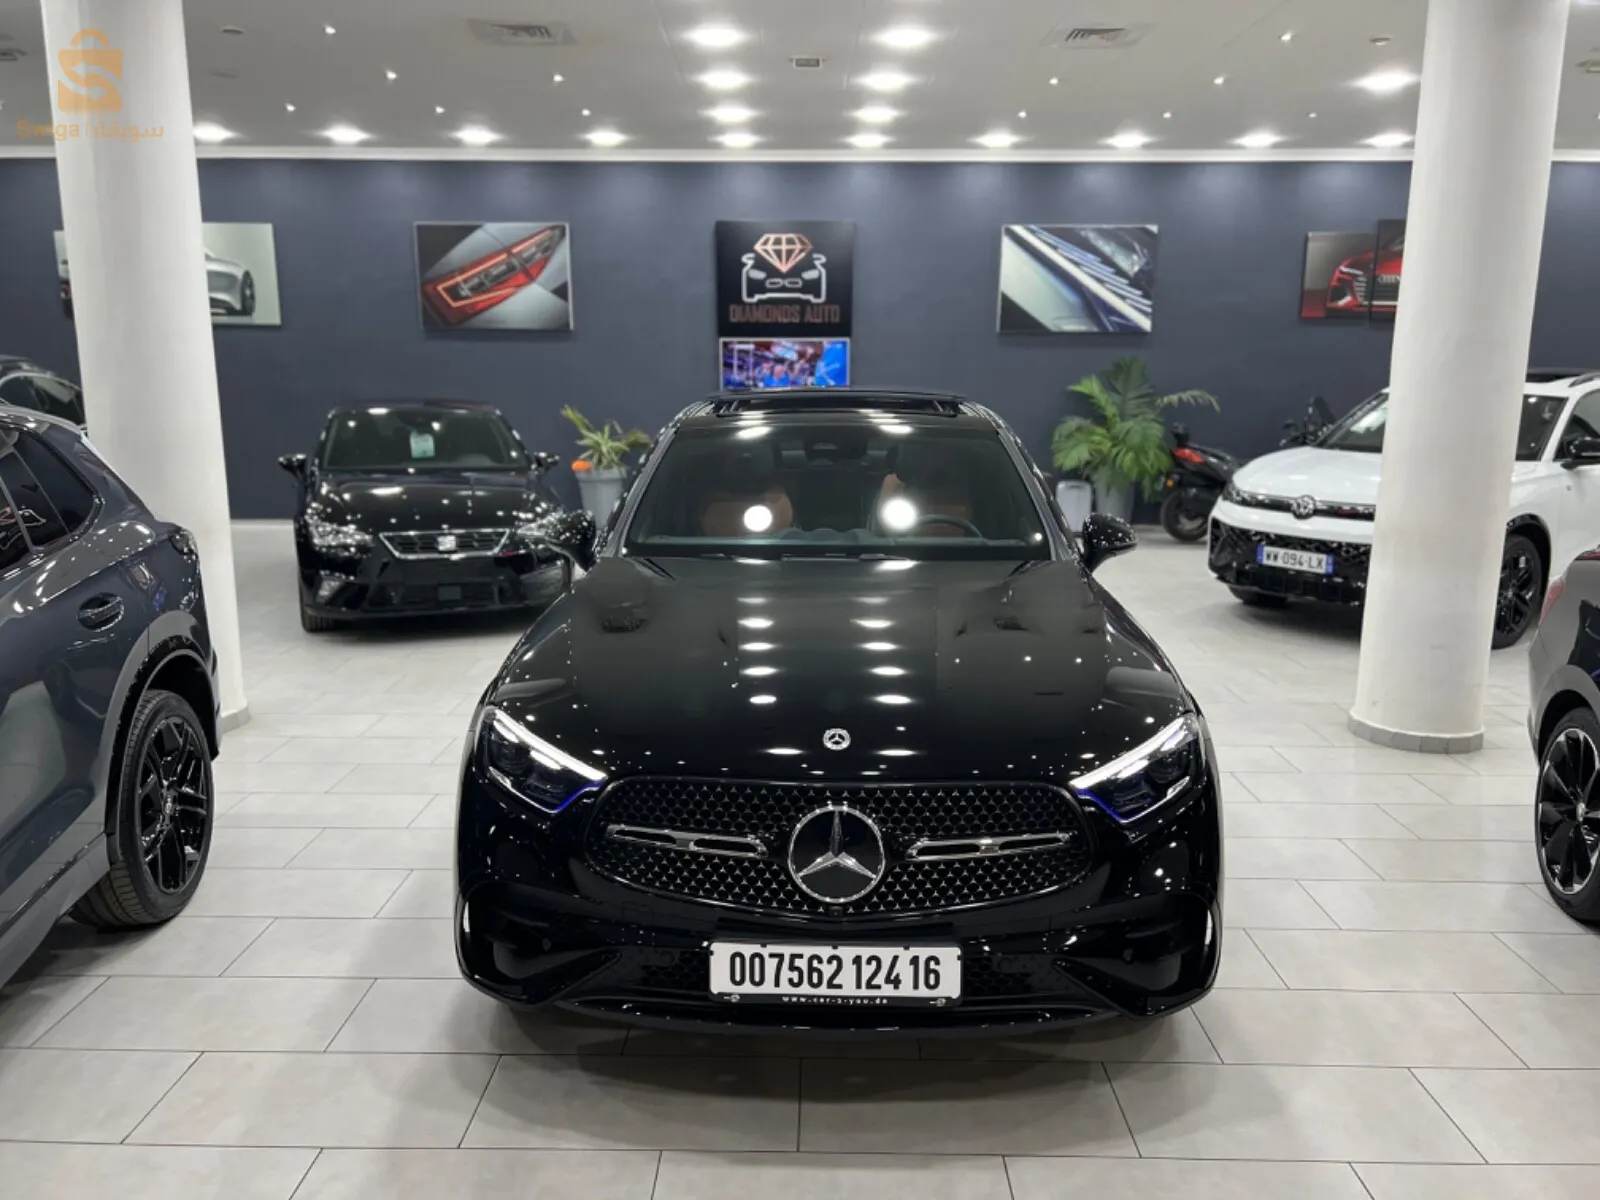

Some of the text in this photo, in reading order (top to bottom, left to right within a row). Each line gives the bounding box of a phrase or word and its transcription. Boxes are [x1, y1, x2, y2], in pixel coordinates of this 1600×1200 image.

[730, 304, 839, 322] DIAMONDS AUTO
[729, 951, 844, 989] 007562
